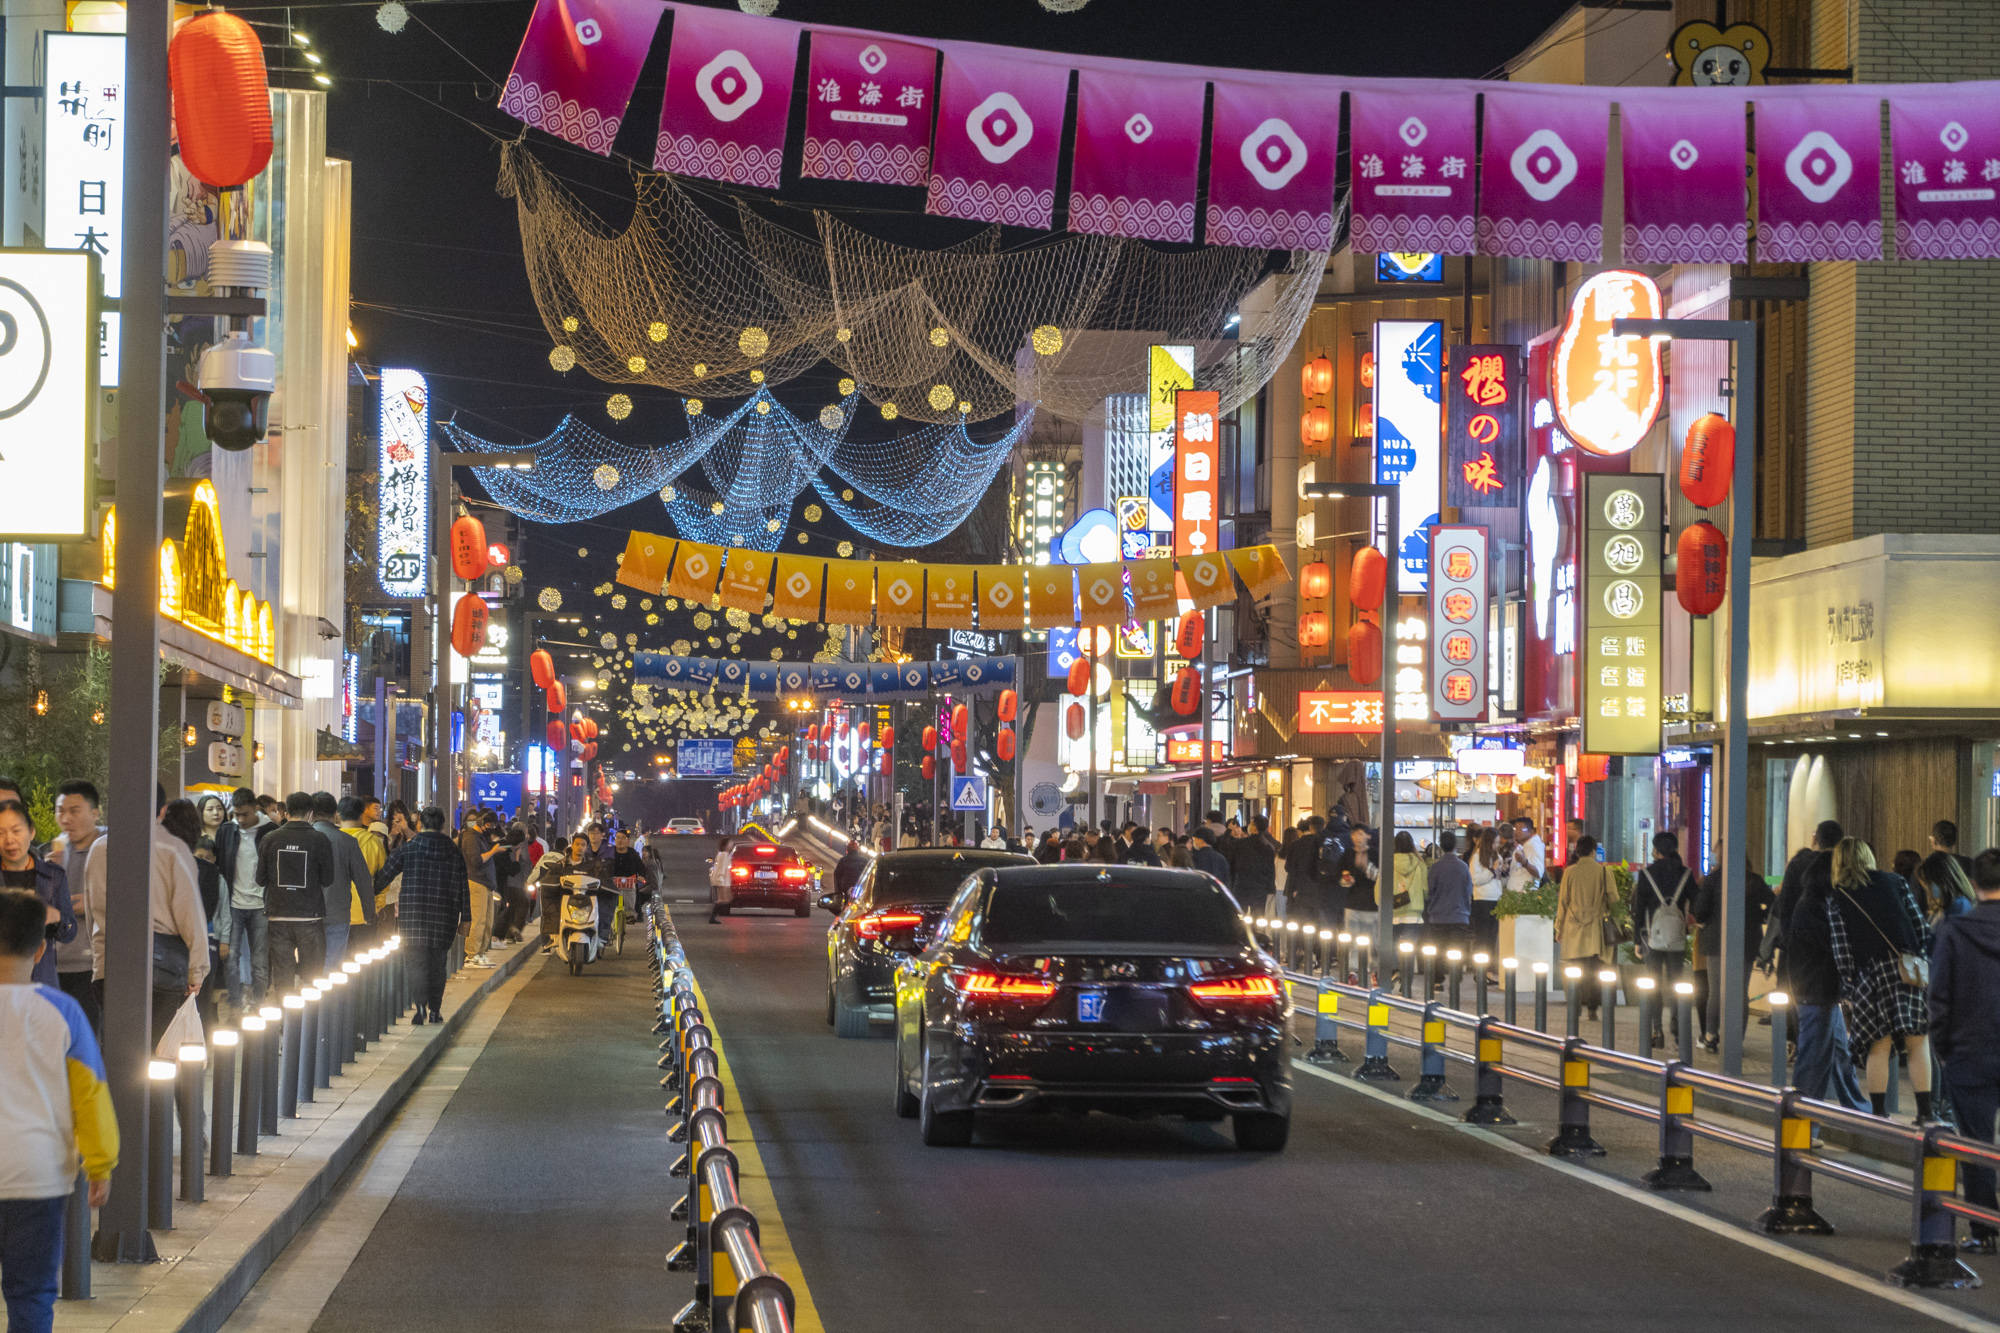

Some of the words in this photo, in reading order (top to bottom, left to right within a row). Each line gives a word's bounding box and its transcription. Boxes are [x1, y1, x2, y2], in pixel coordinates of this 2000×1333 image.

[817, 77, 925, 109] 淮海街
[1359, 153, 1467, 179] 淮海街
[387, 557, 420, 580] 2F
[1446, 552, 1473, 701] 易安烟酒
